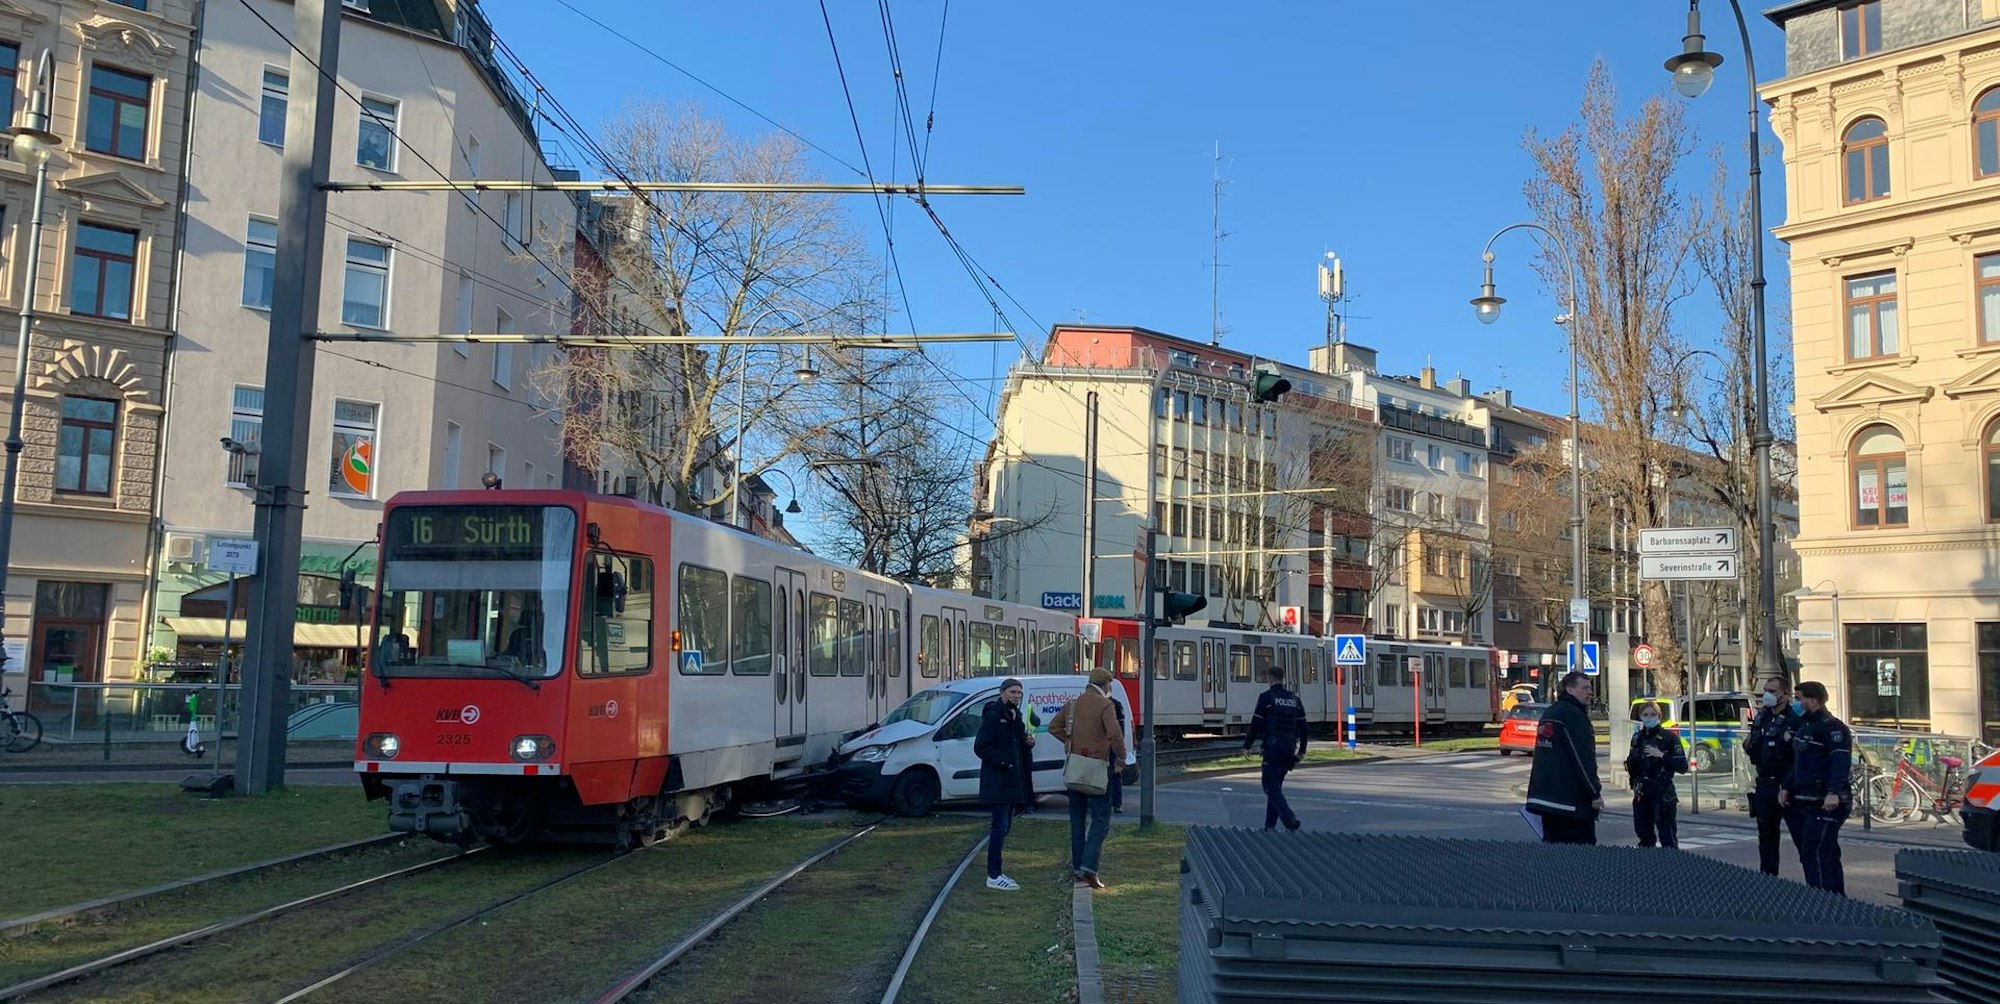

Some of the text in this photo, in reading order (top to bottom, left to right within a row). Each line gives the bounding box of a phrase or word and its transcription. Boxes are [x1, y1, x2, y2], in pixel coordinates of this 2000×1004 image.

[411, 515, 531, 544] 16 Sürth
[1650, 536, 1711, 546] Barbarossaplatz
[1659, 562, 1712, 572] Severinstraße
[1043, 593, 1081, 607] back
[1639, 651, 1649, 661] 30
[436, 709, 461, 720] KVB
[436, 734, 471, 745] 2325
